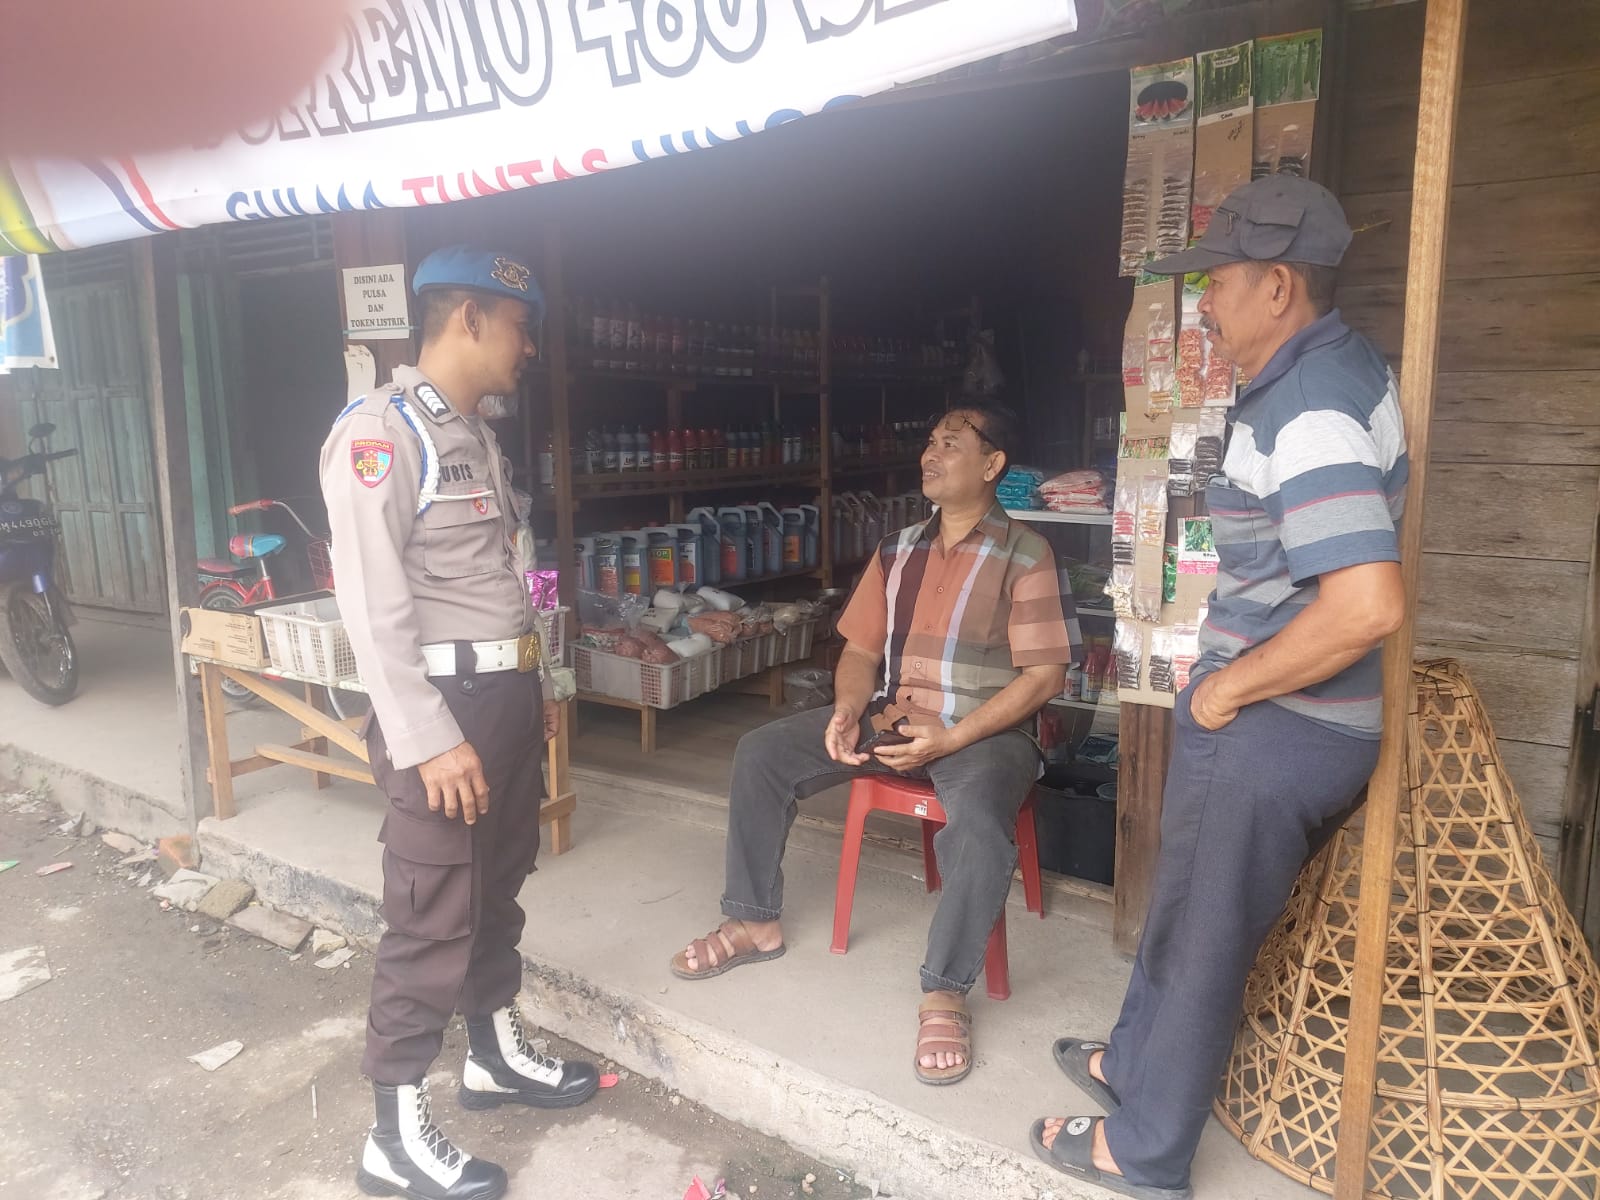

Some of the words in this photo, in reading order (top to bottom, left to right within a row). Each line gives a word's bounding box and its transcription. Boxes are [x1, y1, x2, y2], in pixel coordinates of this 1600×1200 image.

[353, 274, 377, 285] DISINI
[378, 273, 395, 283] ADA
[362, 289, 387, 298] PULSA
[368, 304, 384, 312] DAN
[350, 319, 375, 328] TOKEN
[377, 317, 405, 327] LISTRIK
